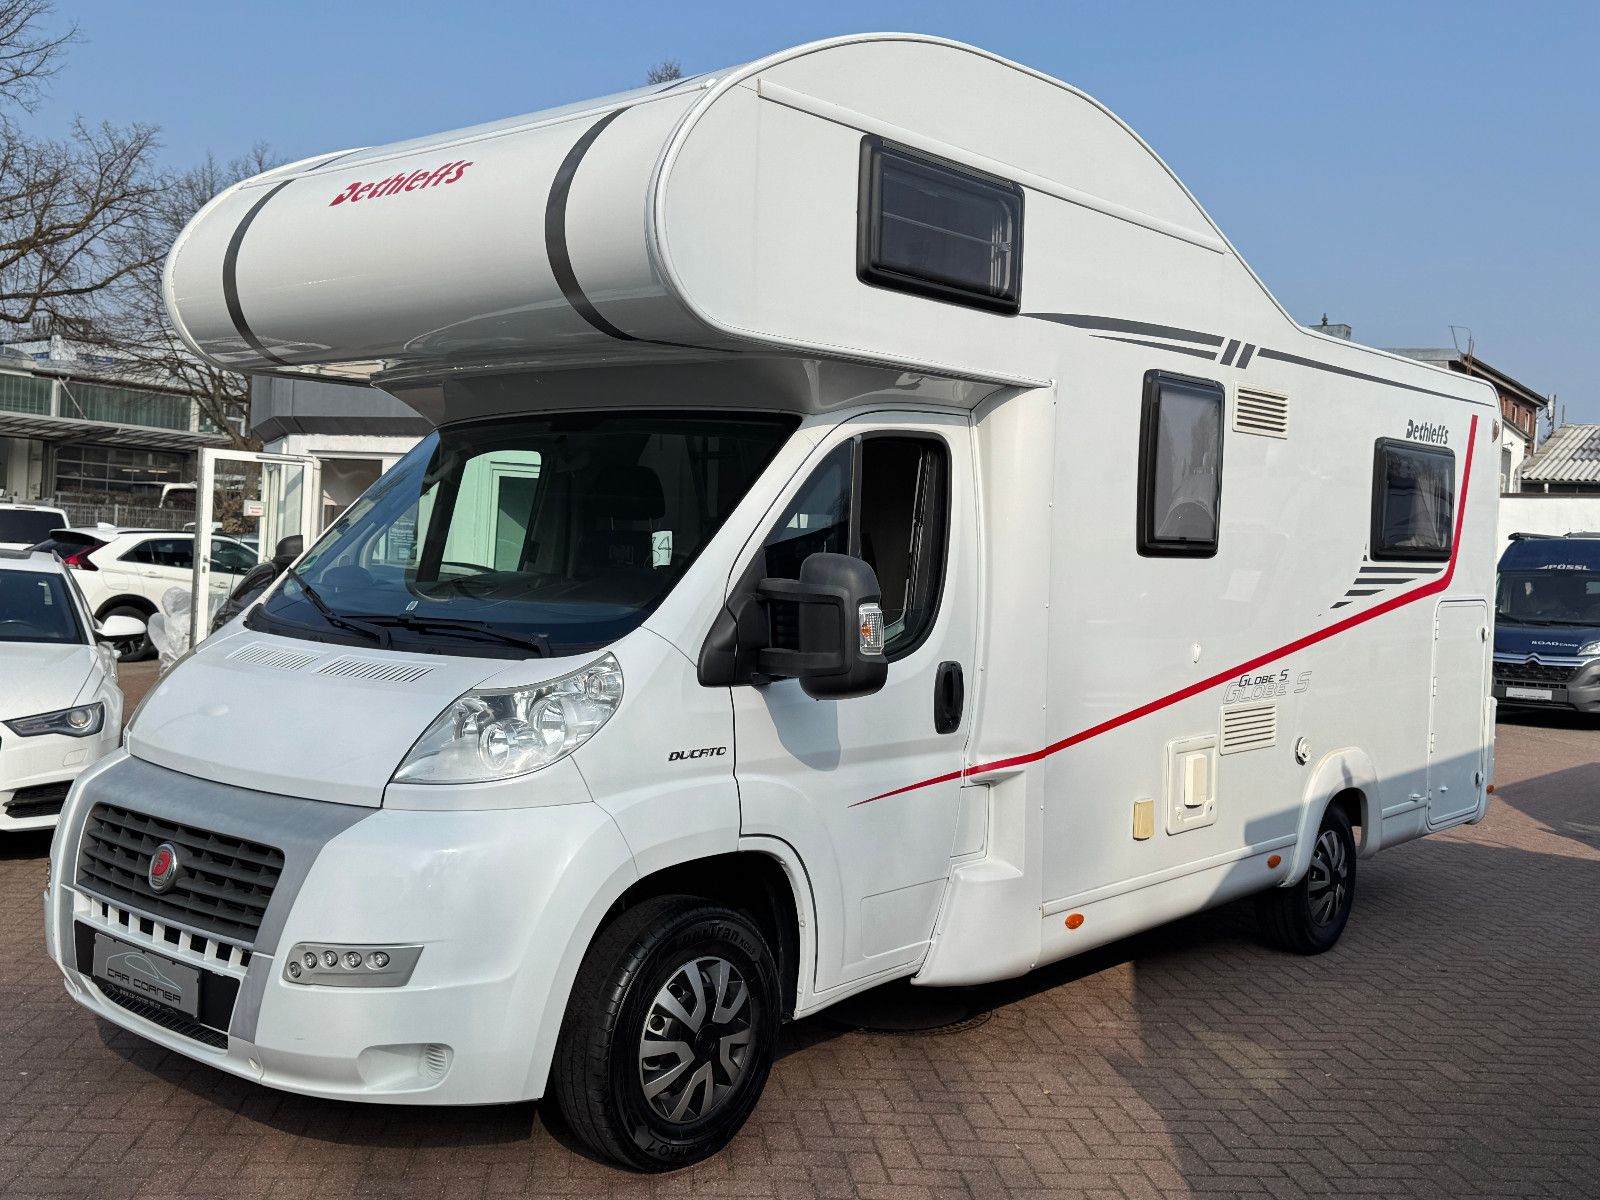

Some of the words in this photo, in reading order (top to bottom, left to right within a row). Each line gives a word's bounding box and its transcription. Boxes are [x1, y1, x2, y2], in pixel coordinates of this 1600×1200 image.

[1548, 563, 1590, 571] PÖSSL
[668, 746, 727, 761] DUCATO
[107, 967, 130, 984] CAR
[133, 978, 182, 1005] CORNER
